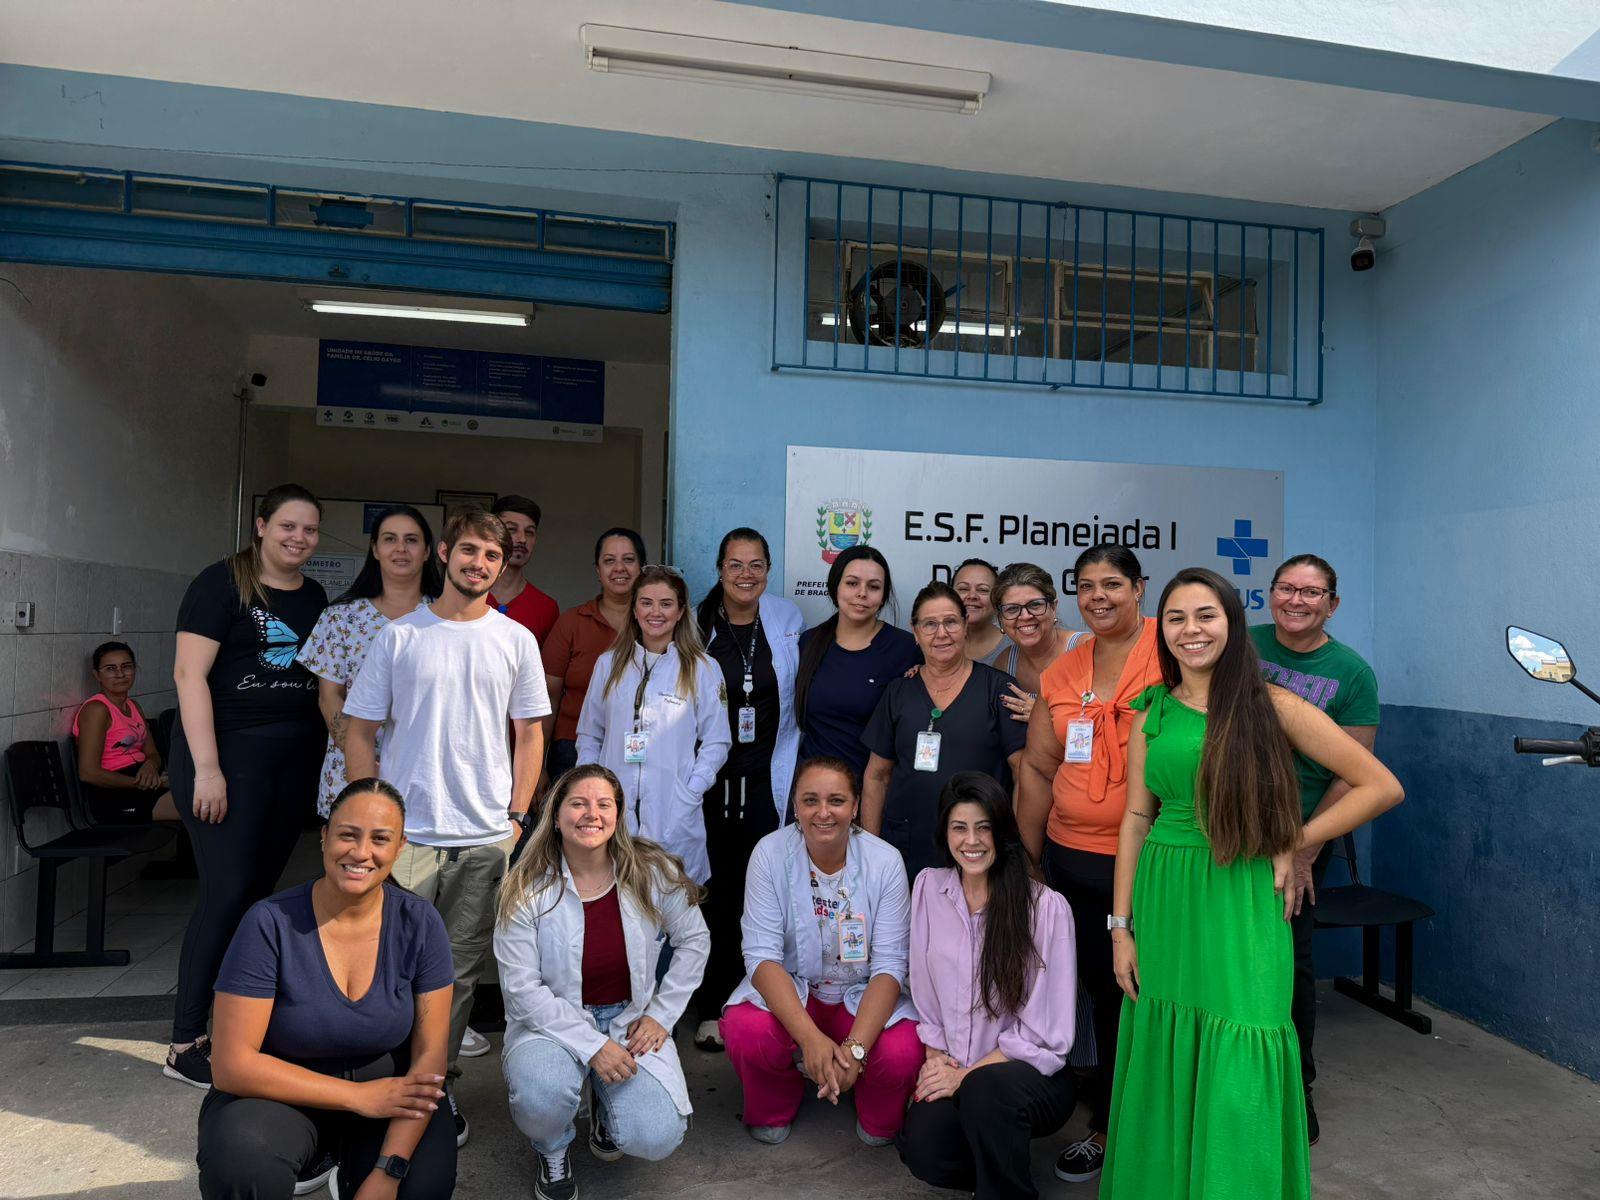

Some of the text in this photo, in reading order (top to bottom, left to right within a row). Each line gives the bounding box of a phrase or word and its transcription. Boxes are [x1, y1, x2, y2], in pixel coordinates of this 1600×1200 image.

[905, 510, 1177, 550] E.S.F. Planejada I
[306, 560, 342, 568] OMETRO
[1236, 589, 1264, 609] US
[237, 673, 267, 690] Eu
[269, 679, 303, 690] sou
[1259, 659, 1340, 710] TTERCUP
